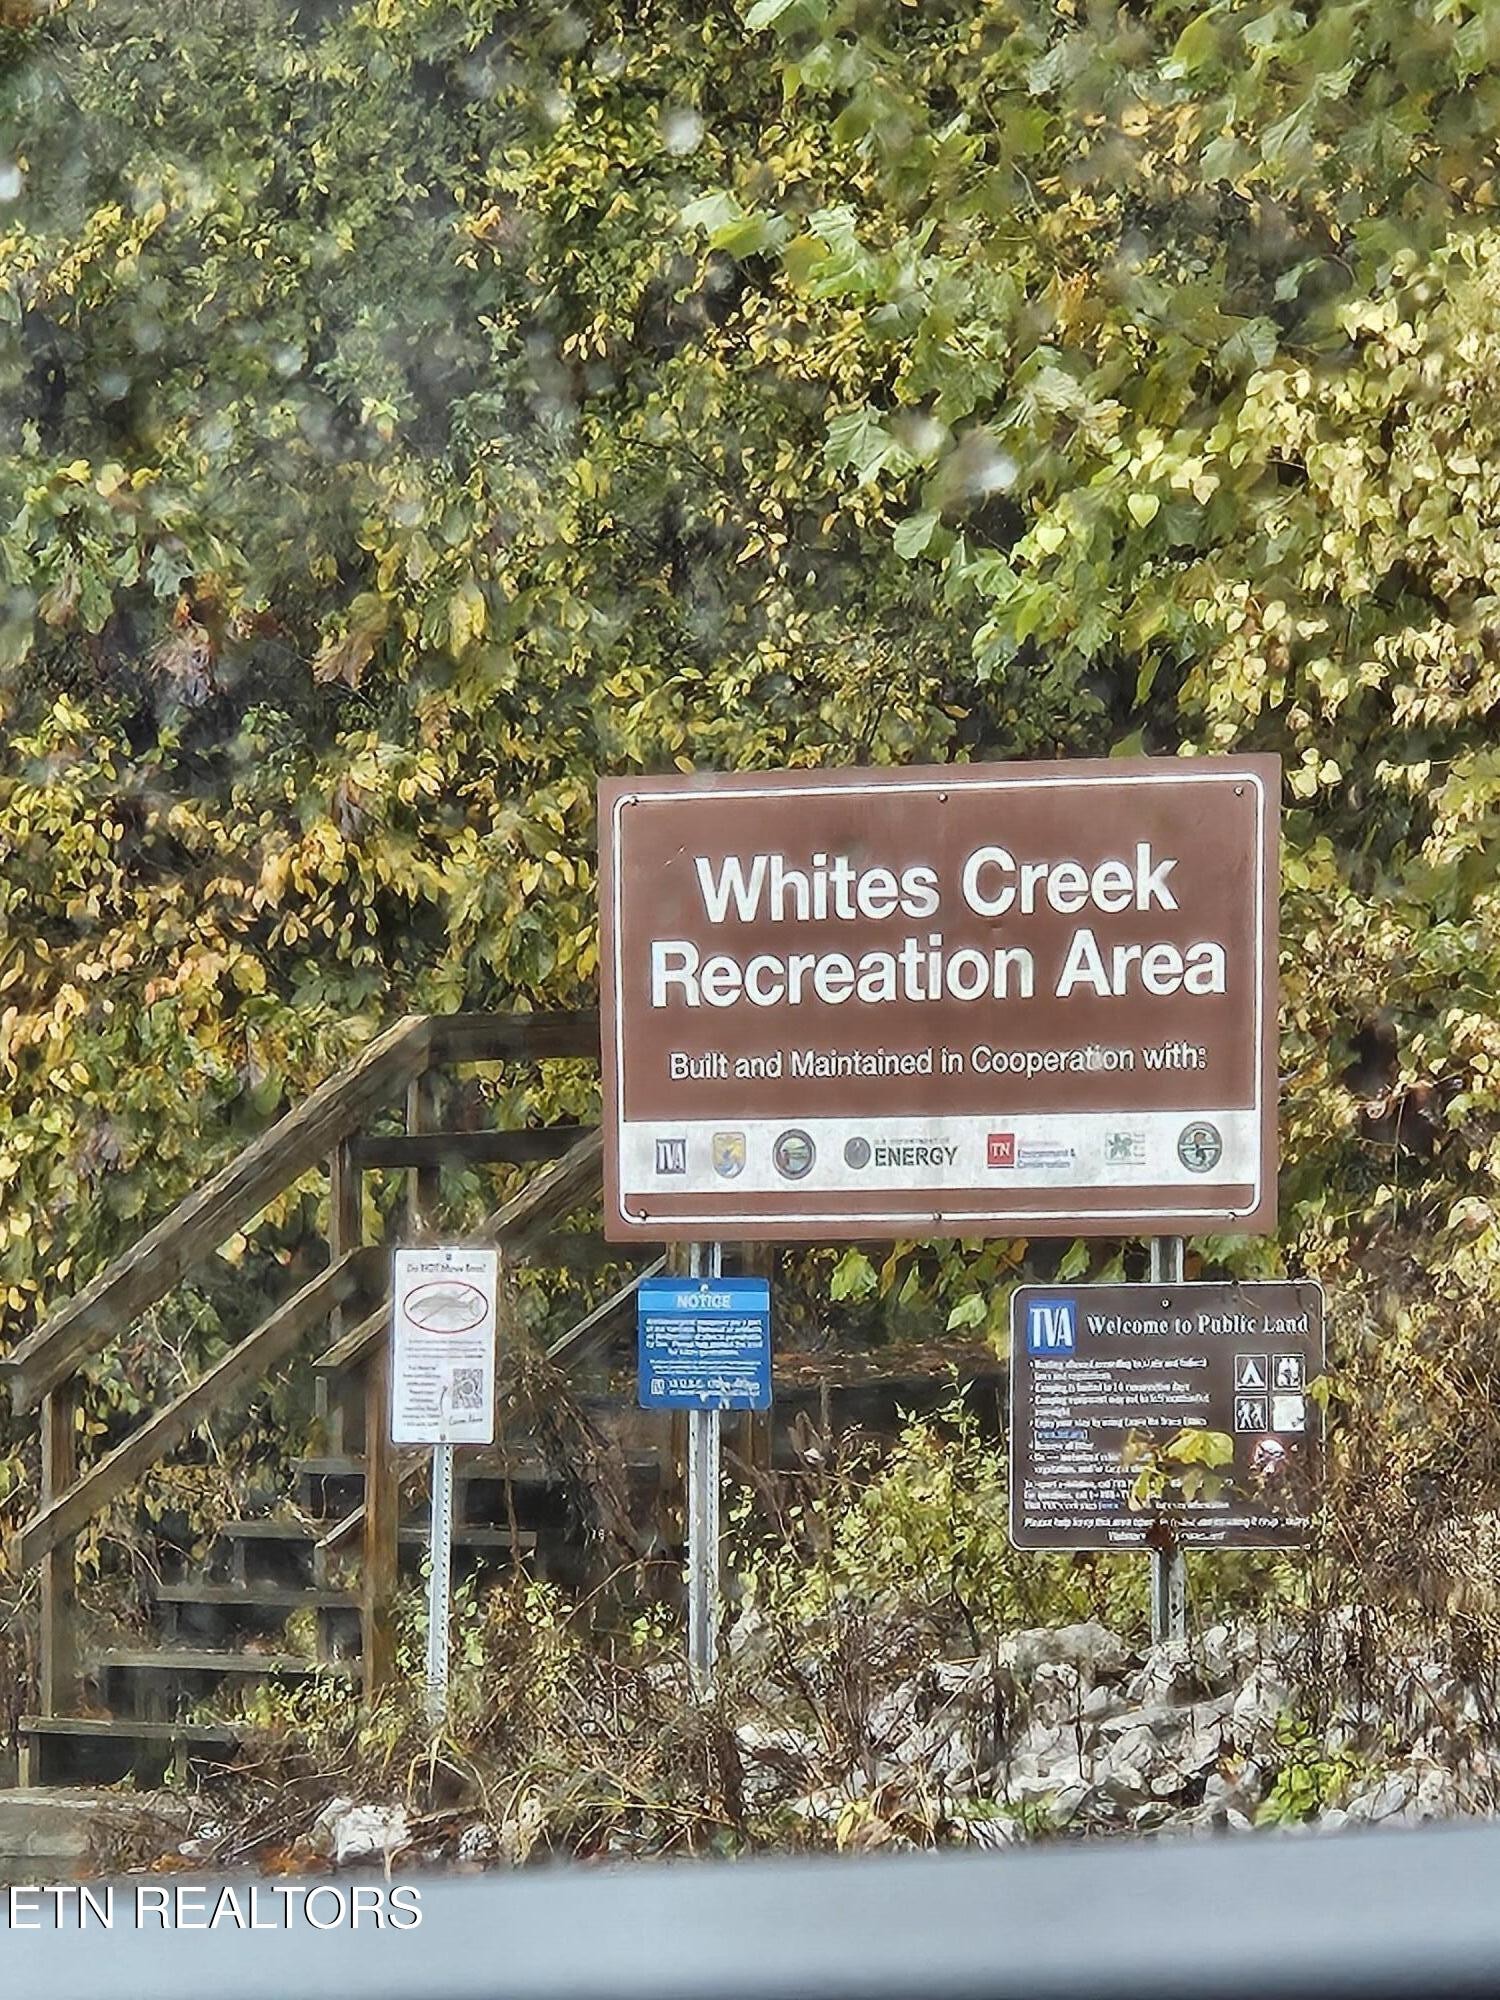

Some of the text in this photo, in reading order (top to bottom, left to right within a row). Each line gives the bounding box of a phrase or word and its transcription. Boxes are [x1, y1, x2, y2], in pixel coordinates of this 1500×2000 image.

[695, 843, 1179, 923] Whites Creek
[651, 929, 1227, 1008] Recreation Area
[670, 1051, 728, 1080] Built
[734, 1051, 783, 1078] and
[791, 1047, 933, 1078] Maintained
[940, 1047, 963, 1073] in
[971, 1044, 1135, 1079] Cooperation
[875, 1146, 959, 1167] ENERGY
[676, 1294, 732, 1309] NOTICE
[1029, 1306, 1074, 1349] TVA
[1087, 1313, 1310, 1336] Welcome to Public Land
